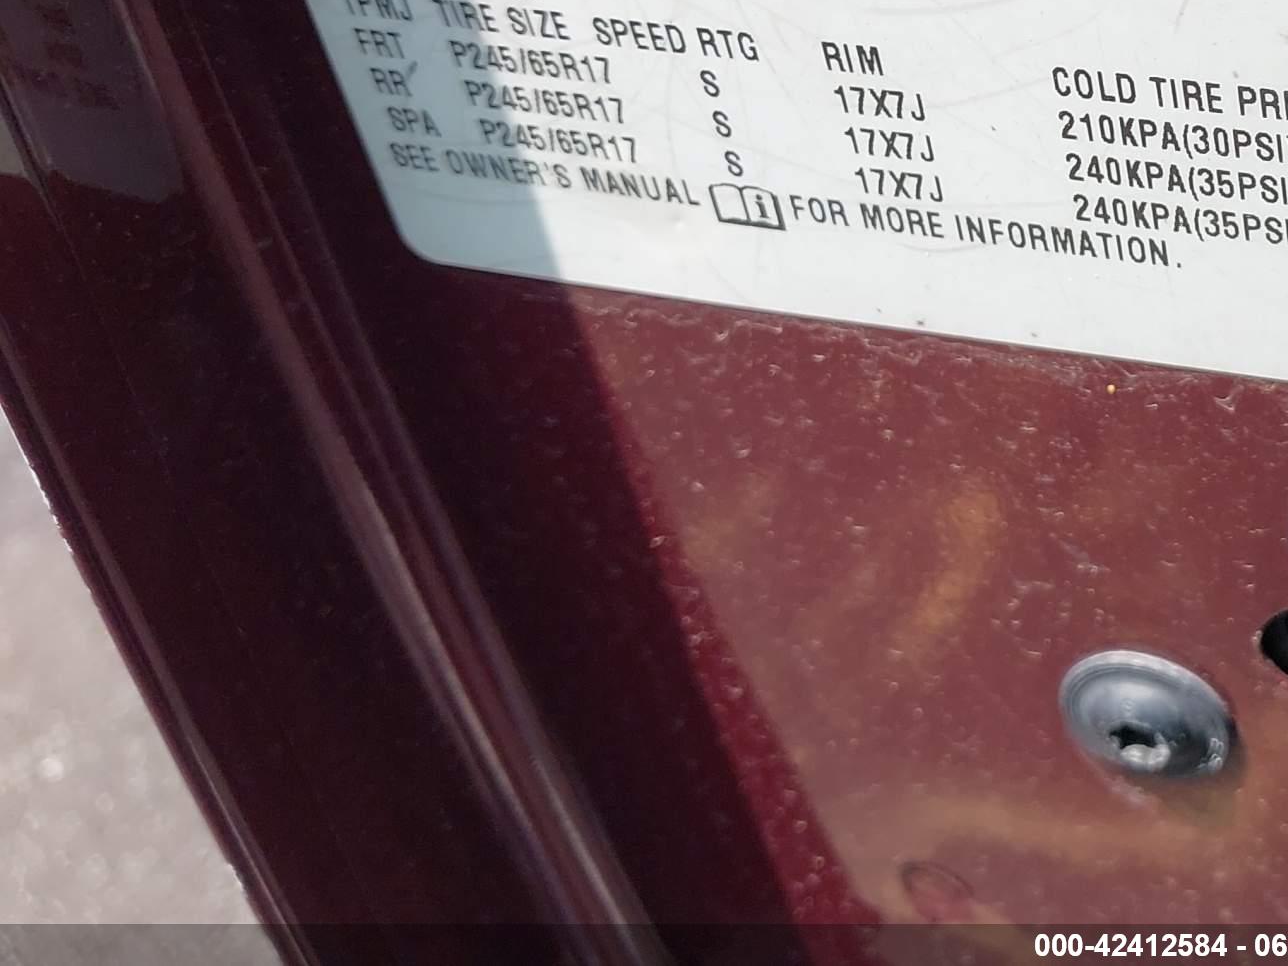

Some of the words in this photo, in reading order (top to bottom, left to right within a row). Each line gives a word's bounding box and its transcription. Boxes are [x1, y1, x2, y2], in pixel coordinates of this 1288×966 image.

[353, 28, 404, 58] FRT
[448, 40, 611, 84] P245/65R17
[700, 70, 720, 97] S
[834, 85, 925, 121] 17X7J
[432, 0, 500, 32] TIRE
[507, 7, 571, 40] SIZE
[593, 17, 686, 53] SPEED
[696, 27, 759, 61] RTG
[821, 42, 884, 76] RIM
[370, 68, 412, 96] RR
[464, 80, 624, 124] P245/65R17
[712, 111, 731, 138] S
[844, 127, 934, 162] 17X7J
[1052, 67, 1136, 103] COLD
[1149, 77, 1223, 113] TIRE
[387, 107, 441, 137] SPA
[478, 119, 636, 164] P245/65R17
[724, 150, 743, 177] S
[855, 167, 943, 202] 17X7J
[390, 143, 439, 171] SEE
[445, 150, 571, 189] OWNER'S
[579, 167, 701, 206] MANUAL
[789, 195, 850, 226] FOR
[860, 203, 944, 238] MORE
[955, 215, 1182, 268] INFORMATION.
